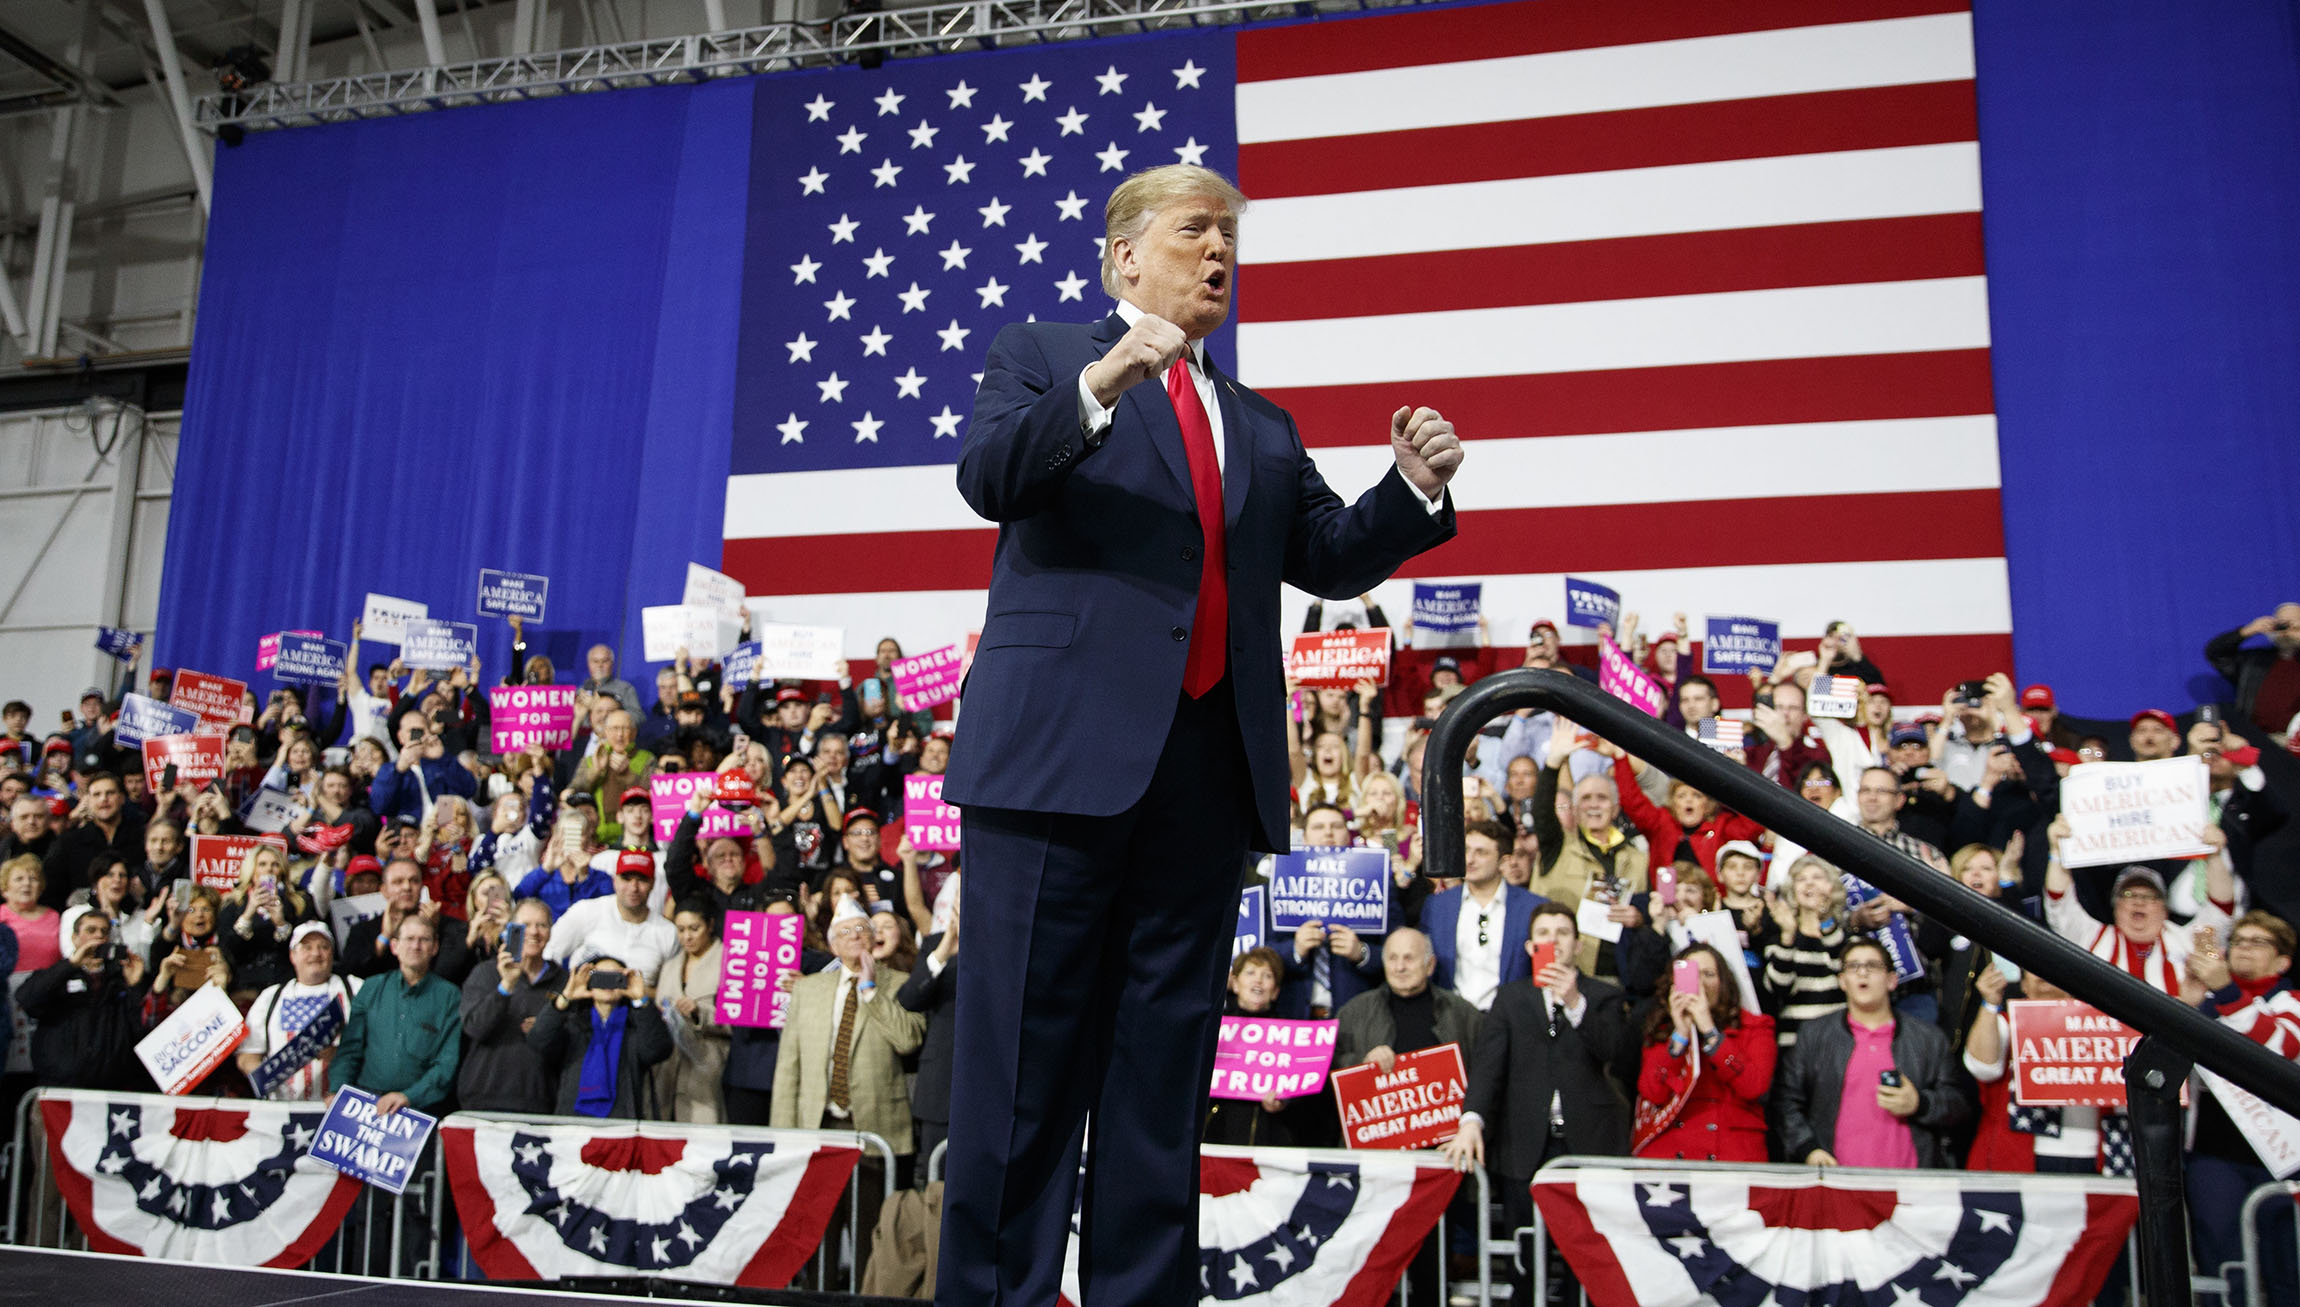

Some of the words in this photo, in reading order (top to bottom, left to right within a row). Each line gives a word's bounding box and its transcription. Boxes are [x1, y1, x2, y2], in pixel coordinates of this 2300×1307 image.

[501, 578, 525, 589] MAKE
[482, 585, 544, 605] AMERICA
[1414, 598, 1480, 616] AMERICA
[301, 641, 326, 653] MAKE
[407, 636, 474, 654] AMERICA
[1322, 636, 1357, 648] MAKE
[1708, 634, 1780, 655] AMERICA
[280, 648, 345, 671] AMERICA
[891, 646, 962, 679] WOMEN
[1292, 647, 1386, 666] AMERICA
[915, 671, 943, 688] FOR
[1296, 665, 1337, 679] GREAT
[1338, 666, 1380, 679] AGAIN
[1604, 637, 1662, 708] WOMEN
[198, 680, 223, 691] MAKE
[904, 680, 961, 708] TRUM
[176, 686, 241, 708] AMERICA
[490, 690, 576, 708] WOMEN
[519, 712, 550, 726] FOR
[495, 729, 570, 748] TRUMP
[2104, 773, 2144, 791] BUY
[2071, 784, 2193, 815] AMERICAN
[935, 805, 961, 820] FO
[2108, 809, 2153, 829] HIRE
[910, 825, 961, 844] TRU
[2073, 822, 2205, 854] AMERICAN
[1305, 858, 1347, 873] MAKE
[1273, 876, 1383, 900] AMERICA
[1274, 899, 1329, 917] STRONG
[1331, 901, 1383, 918] AGAIN
[722, 918, 752, 1019] TRUMP
[751, 950, 770, 990] FOR
[2065, 1015, 2122, 1032] MAKE
[161, 1013, 227, 1076] SACCONE
[1218, 1023, 1337, 1047] WOMEN
[154, 1040, 180, 1064] RICK
[1244, 1050, 1292, 1068] FOR
[2019, 1035, 2143, 1064] AMERI
[1210, 1069, 1320, 1095] TRUMP
[1375, 1066, 1419, 1091] MAKE
[2029, 1066, 2097, 1085] GREAT
[1346, 1077, 1466, 1127] AMERICA
[341, 1096, 419, 1140] DRAIN
[1356, 1117, 1407, 1144] GREAT
[1409, 1103, 1462, 1130] AGAIN
[356, 1124, 386, 1147] THE
[318, 1130, 406, 1178] SWAMP
